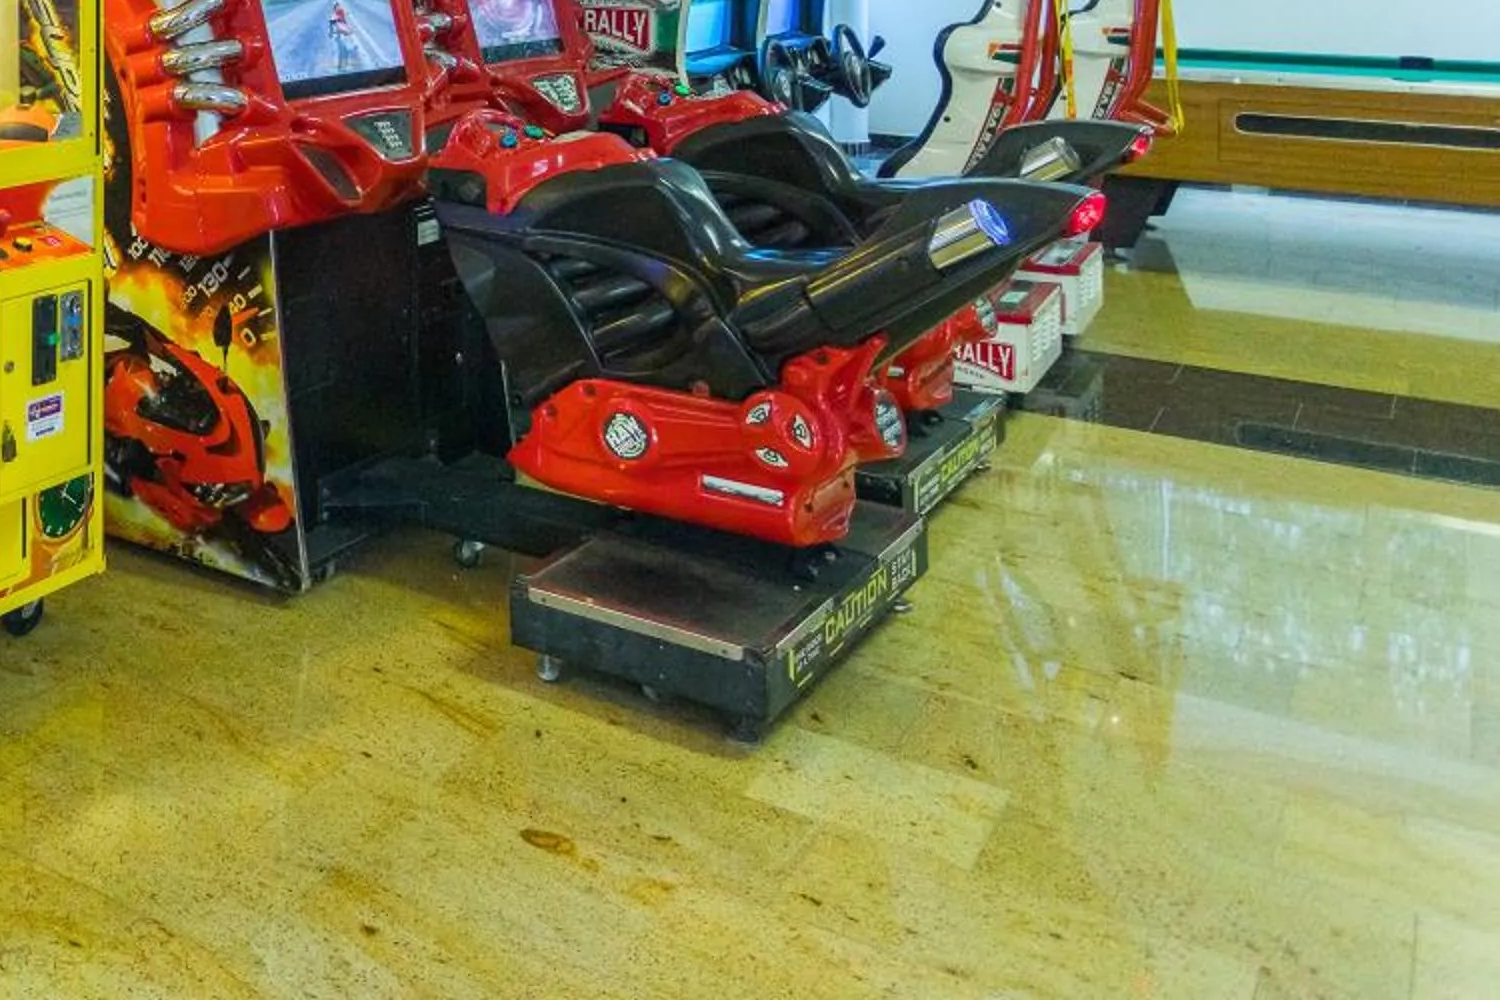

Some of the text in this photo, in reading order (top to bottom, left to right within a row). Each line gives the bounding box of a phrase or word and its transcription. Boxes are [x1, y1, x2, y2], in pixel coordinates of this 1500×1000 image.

[585, 9, 647, 46] RALLY
[197, 261, 229, 298] 130
[825, 567, 888, 645] CAUTION
